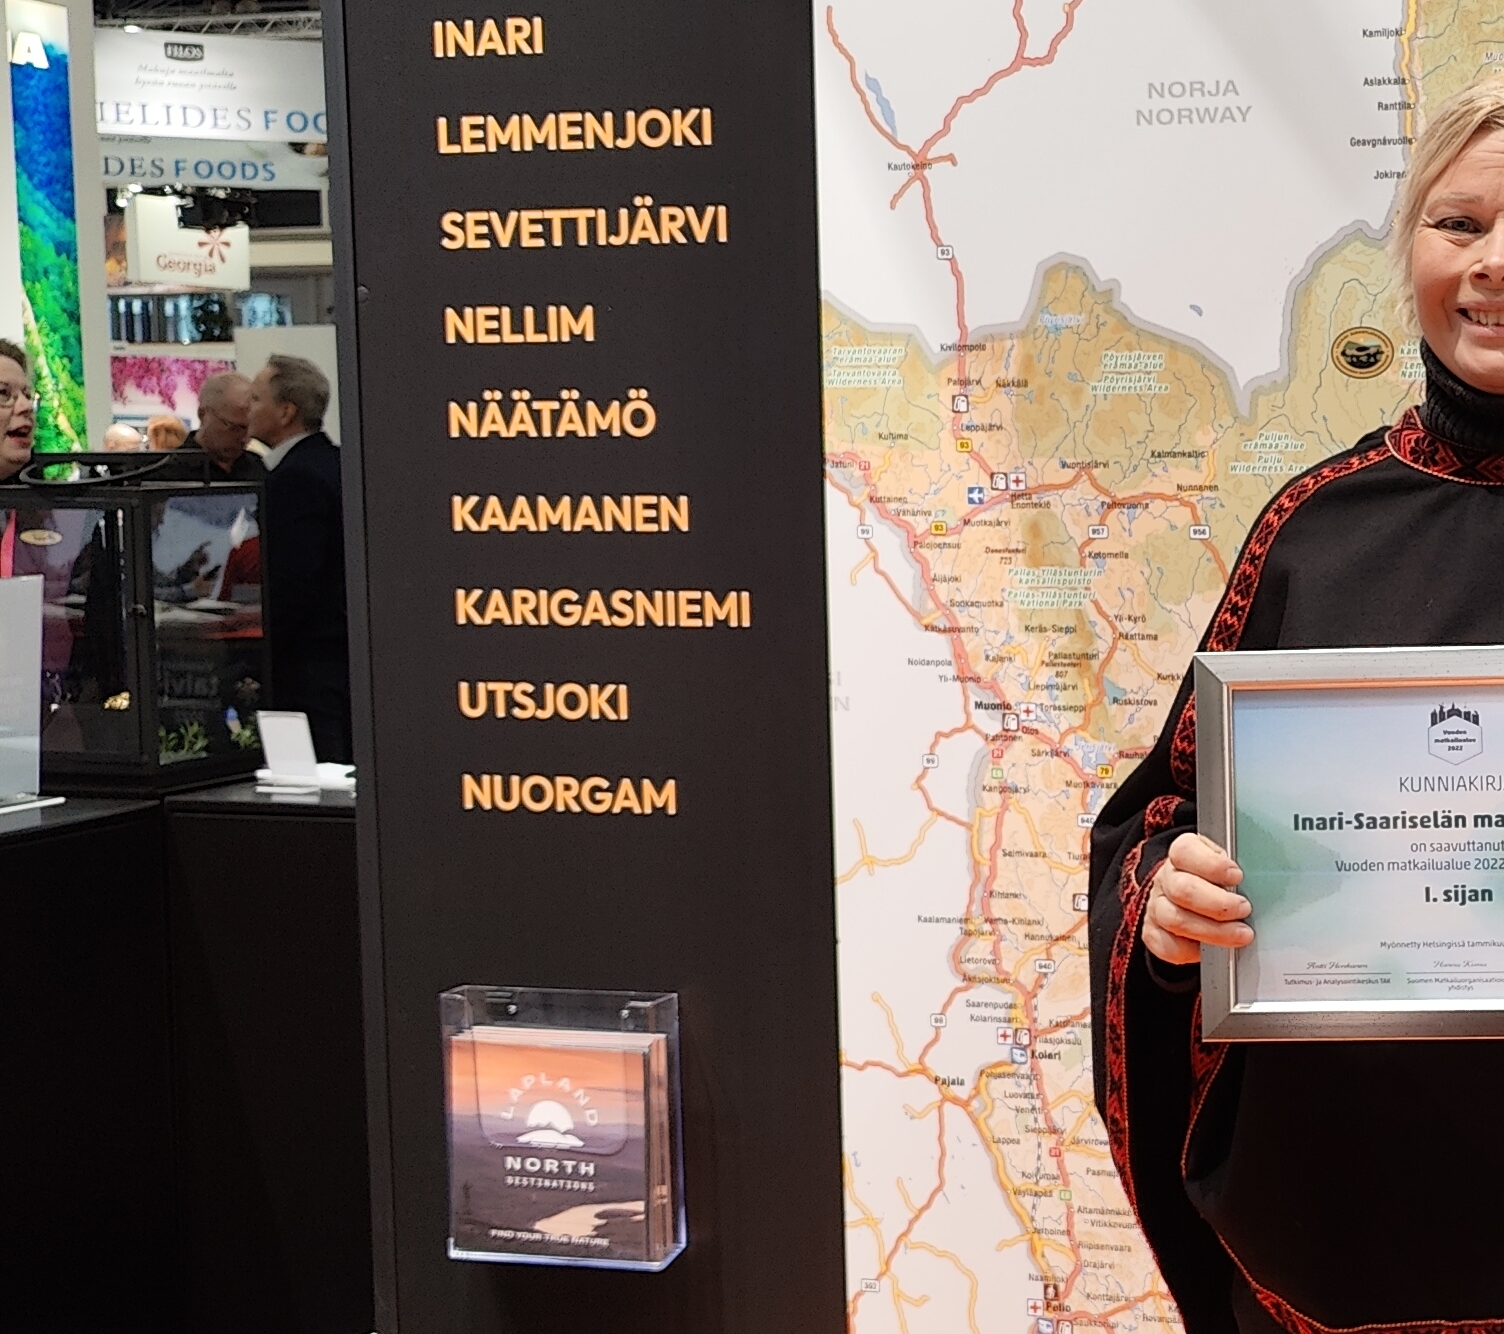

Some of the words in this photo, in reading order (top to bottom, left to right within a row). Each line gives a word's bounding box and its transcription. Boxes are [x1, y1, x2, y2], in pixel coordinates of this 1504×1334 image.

[432, 16, 544, 58] INARI
[1147, 80, 1240, 100] NORJA
[1136, 106, 1253, 127] NORWAY
[436, 107, 713, 154] LEMMENJOKI
[174, 158, 276, 181] FOODS
[440, 194, 728, 249] SEVETTIJÄRVI
[156, 255, 217, 274] Georgia
[444, 305, 595, 344] NELLIM
[449, 388, 657, 438] NÄÄTÄMÖ
[451, 495, 689, 532] KAAMANEN
[455, 588, 750, 628] KARIGASNIEMI
[458, 681, 628, 721] UTSJOKI
[974, 701, 1012, 711] Muonio
[462, 774, 677, 815] NUORGAM
[1293, 810, 1467, 831] Inari-Saariselän
[1410, 843, 1426, 852] on
[1429, 839, 1504, 852] saavuttanut
[1335, 860, 1384, 872] Vuoden
[1387, 858, 1470, 871] matkailualue
[1442, 885, 1493, 906] sijan
[1379, 940, 1421, 950] Myönnetty
[1423, 939, 1466, 949] Helsingissä
[1031, 1049, 1061, 1061] Kolari
[935, 1076, 965, 1088] Pajala
[502, 1072, 599, 1127] LAPLAND
[505, 1156, 595, 1177] NORTH
